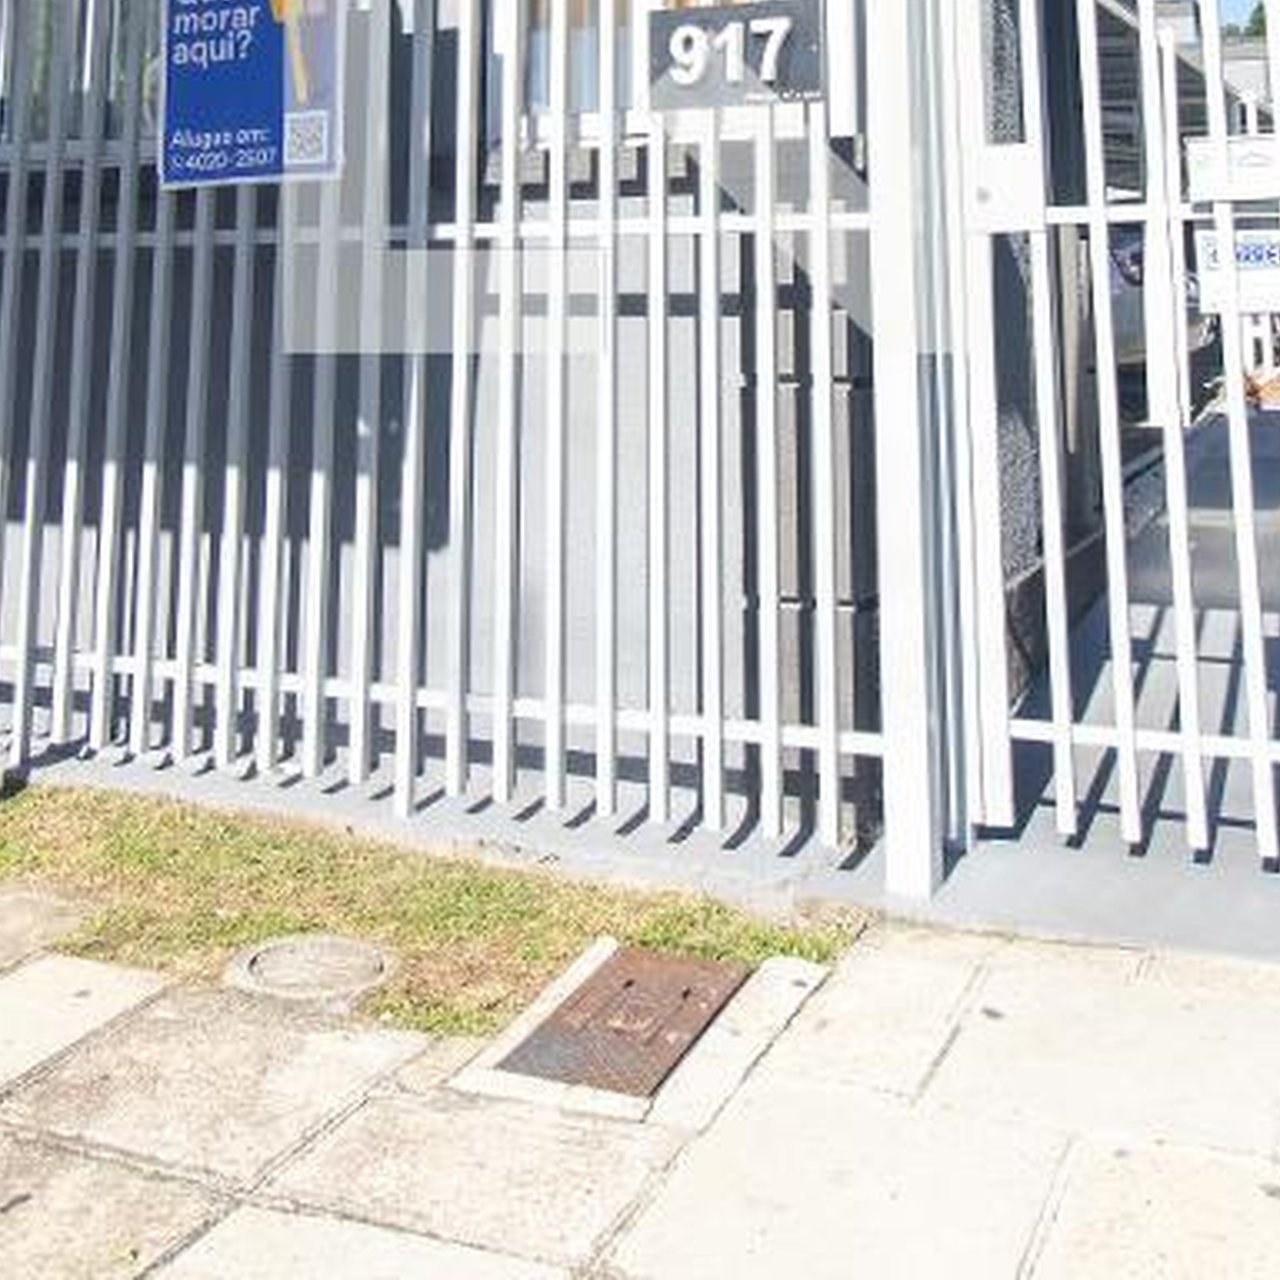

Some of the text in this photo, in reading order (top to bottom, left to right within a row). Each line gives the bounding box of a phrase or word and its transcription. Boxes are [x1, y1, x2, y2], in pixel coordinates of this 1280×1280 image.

[174, 4, 261, 34] morar
[173, 31, 253, 67] aqui?
[669, 16, 792, 85] 917
